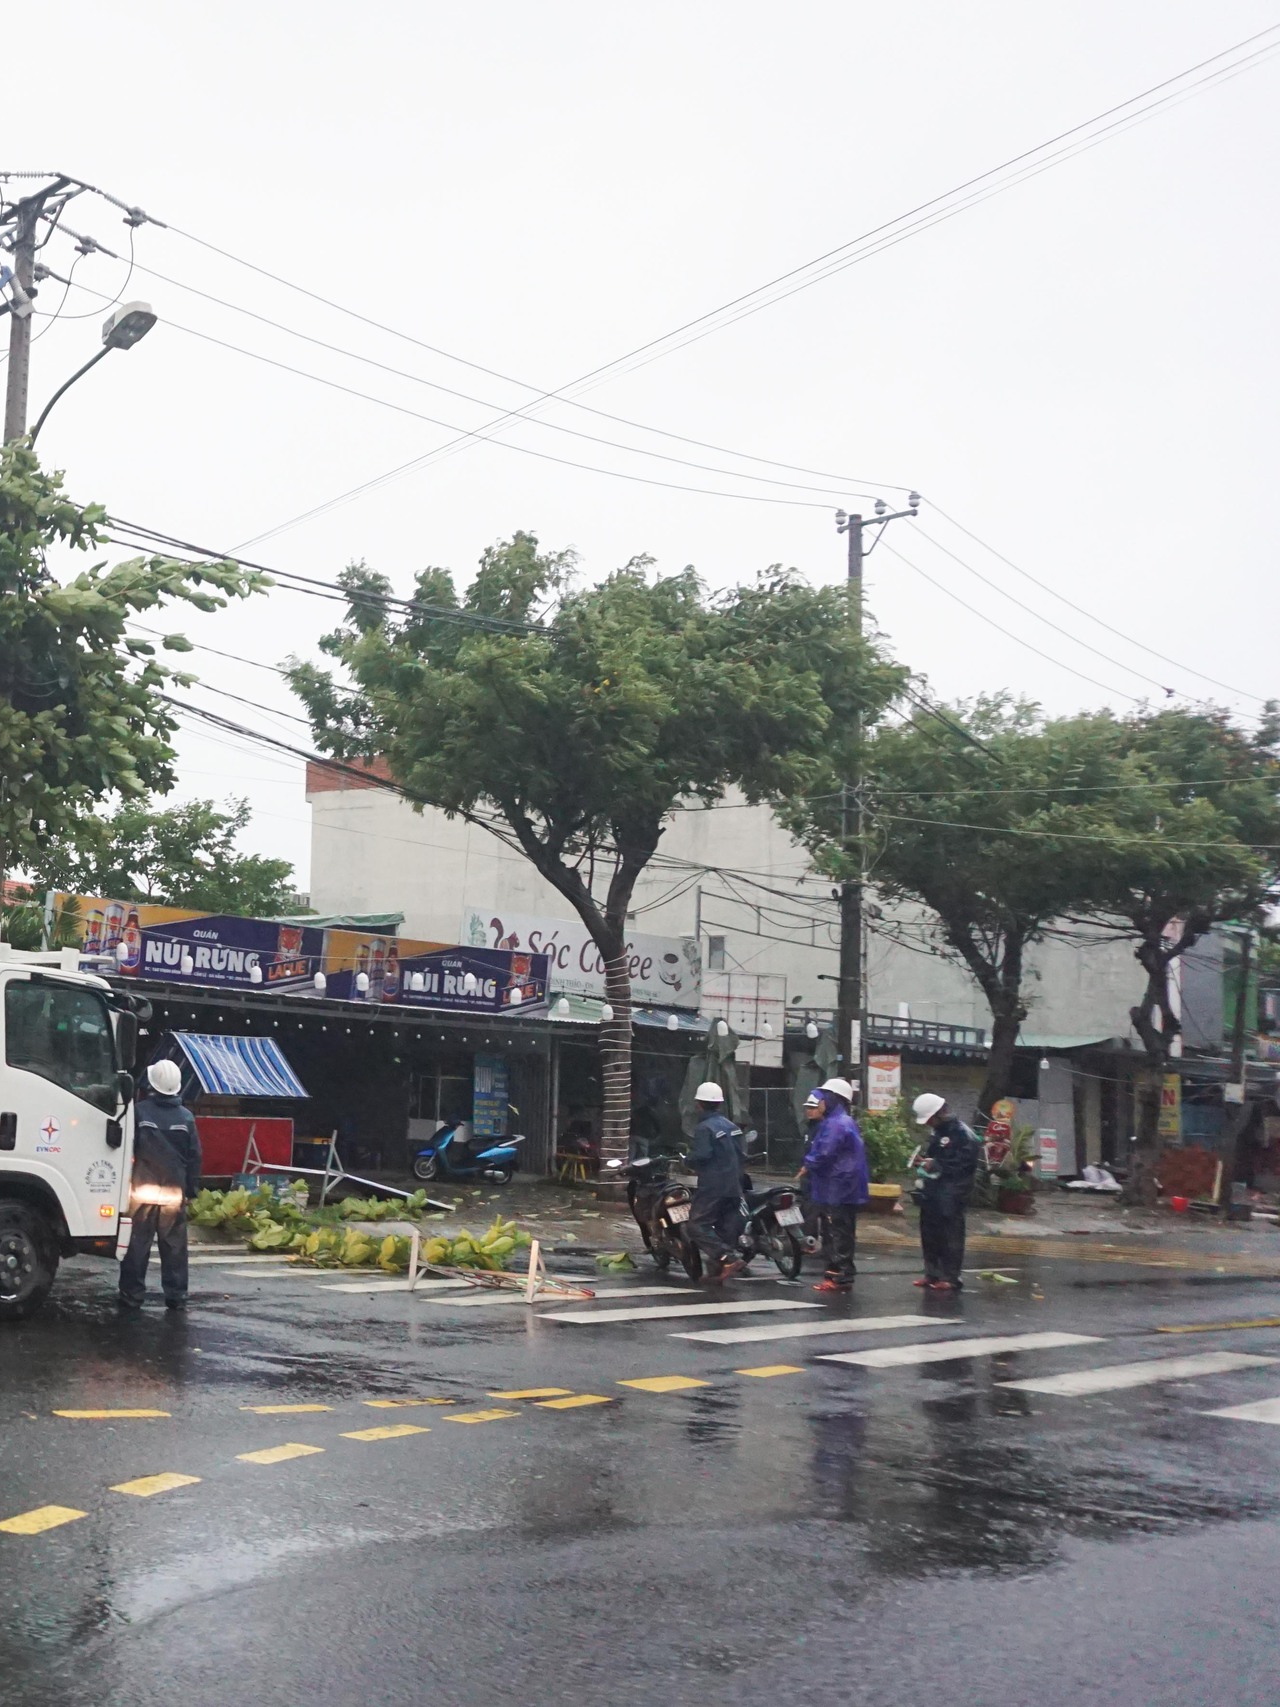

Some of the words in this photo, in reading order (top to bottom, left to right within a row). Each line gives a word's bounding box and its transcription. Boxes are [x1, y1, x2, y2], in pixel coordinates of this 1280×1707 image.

[193, 928, 219, 940] QUÁN
[528, 930, 571, 969] Sóc
[579, 938, 653, 982] Cofee
